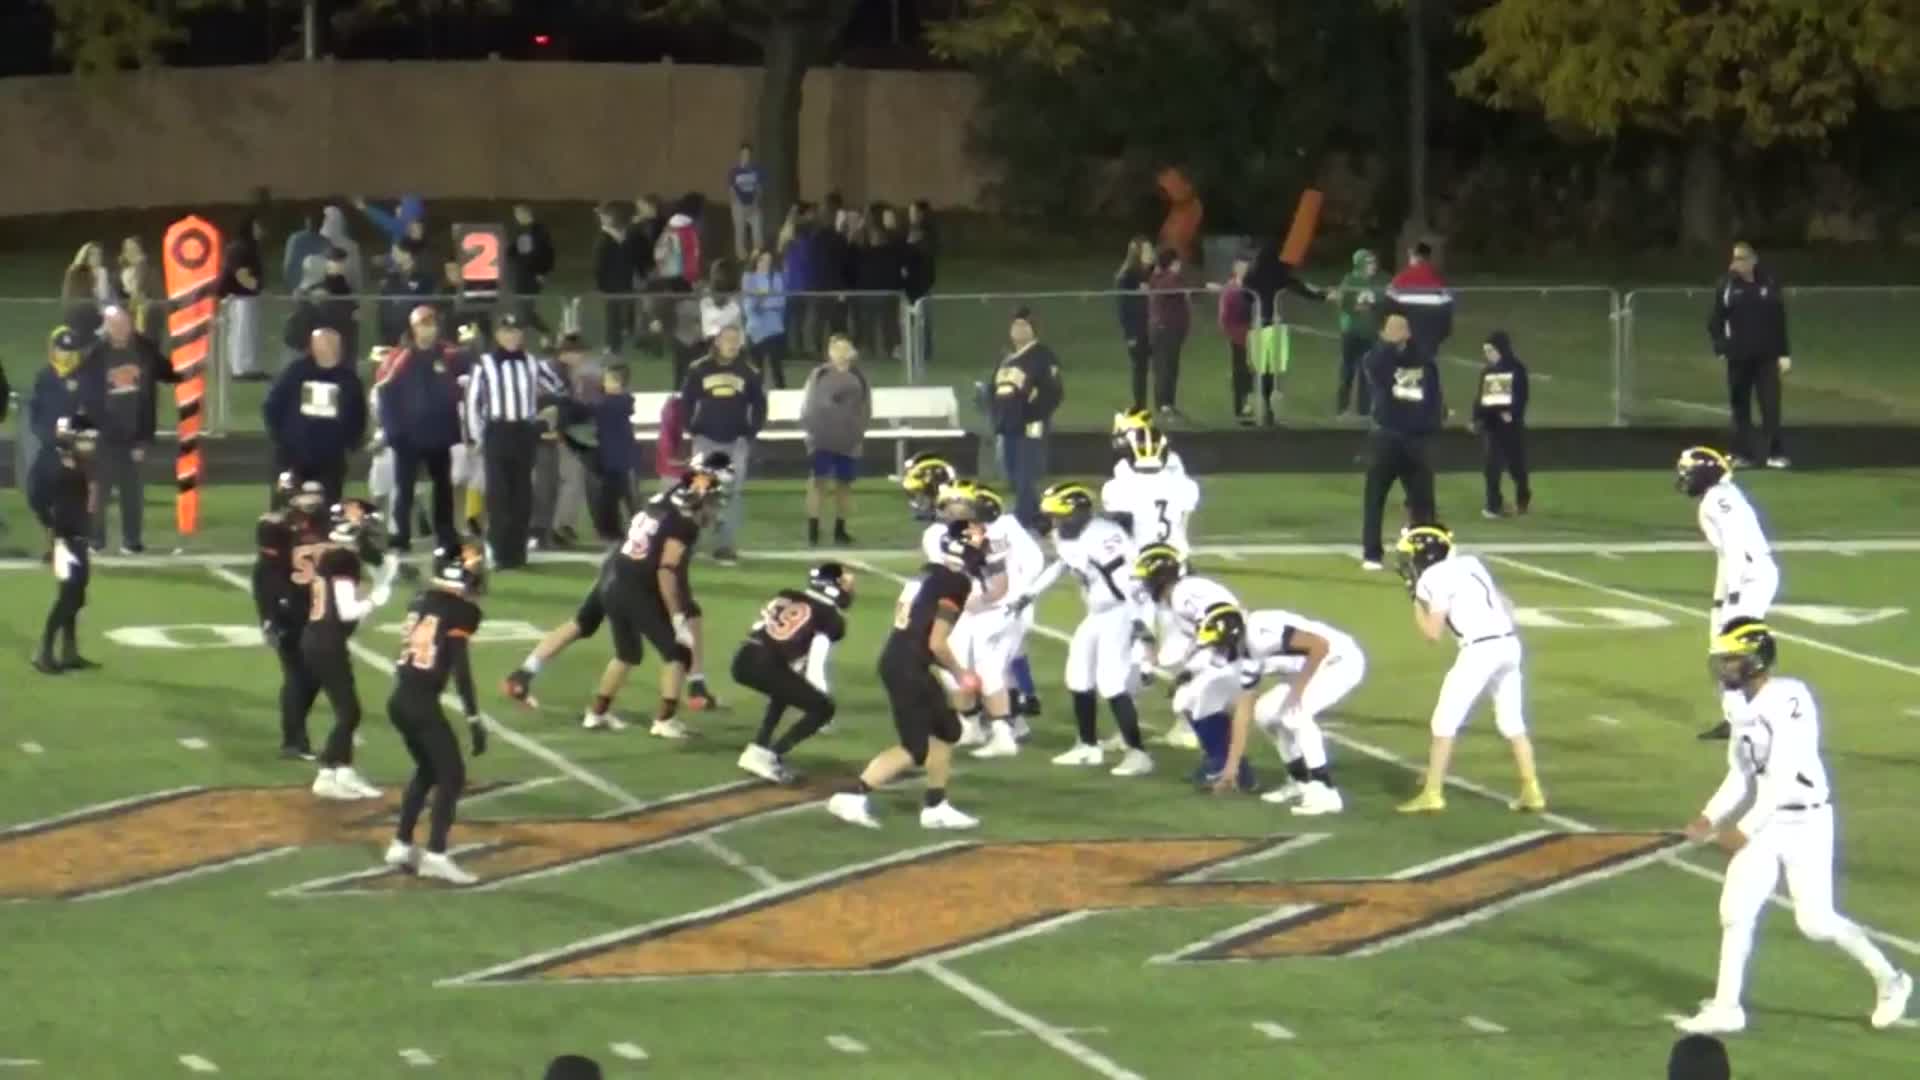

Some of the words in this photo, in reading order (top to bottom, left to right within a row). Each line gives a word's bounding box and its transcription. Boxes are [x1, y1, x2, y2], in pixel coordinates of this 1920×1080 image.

[462, 232, 498, 279] 2
[1154, 499, 1171, 543] 3
[1786, 696, 1803, 720] 2
